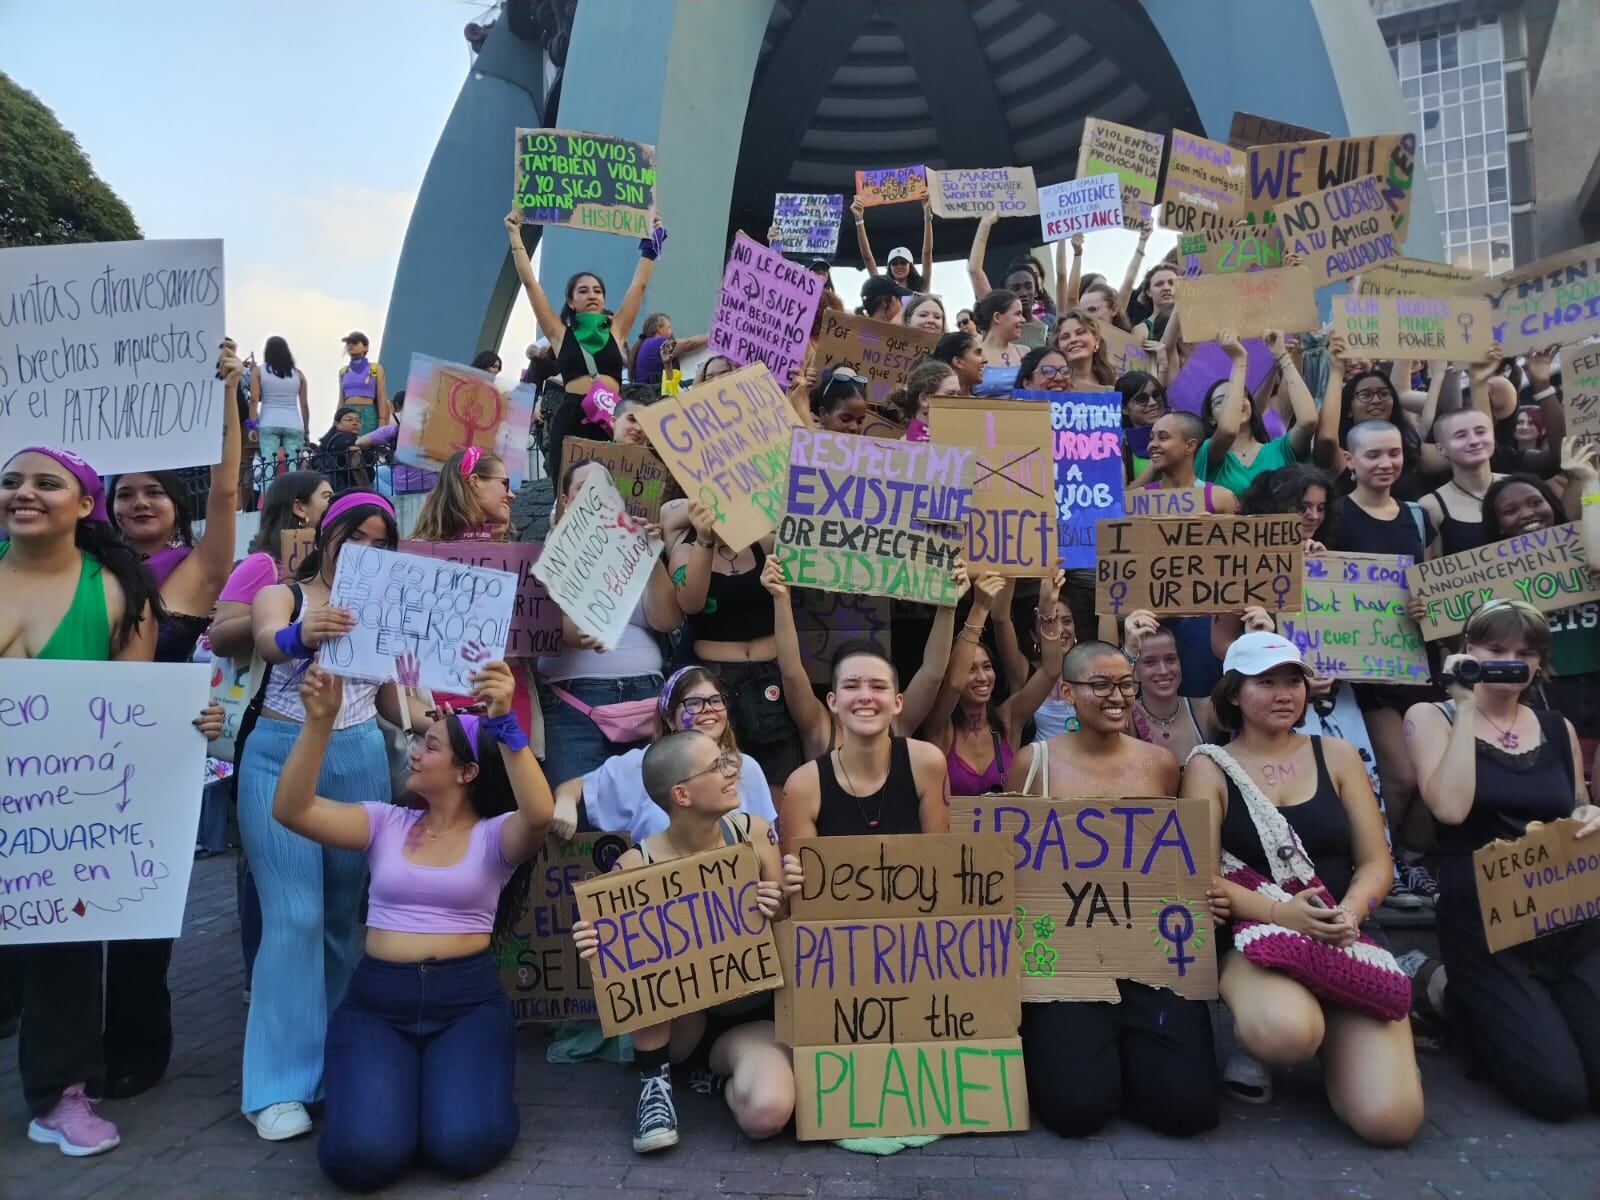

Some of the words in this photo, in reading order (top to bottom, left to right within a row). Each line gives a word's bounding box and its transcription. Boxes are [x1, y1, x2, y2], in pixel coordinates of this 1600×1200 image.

[527, 135, 558, 153] LOS
[568, 137, 636, 163] NOVIOS
[1095, 138, 1116, 152] SON
[1119, 146, 1136, 159] LOS
[1139, 153, 1158, 168] QUE
[1097, 127, 1160, 155] VIOLENTOS
[520, 154, 597, 177] TAMBIÉN
[942, 172, 952, 183] I
[958, 169, 1009, 182] MARCH
[1090, 149, 1143, 173] PROVOCAN
[1175, 162, 1190, 174] con
[1192, 167, 1207, 181] mis
[1210, 174, 1240, 192] amigos
[1251, 147, 1306, 200] WE
[515, 194, 573, 209] CONTAR
[520, 175, 530, 192] Y
[536, 175, 554, 193] YO
[561, 178, 602, 199] SIGO
[615, 182, 643, 204] SIN
[943, 182, 960, 191] SO
[962, 182, 979, 191] MY
[979, 190, 994, 198] BE
[1058, 184, 1115, 207] EXISTENCE
[581, 207, 650, 237] HISTORIA
[998, 200, 1026, 211] TOO
[1047, 208, 1121, 236] RESISTANCE
[1165, 200, 1196, 232] POR
[1284, 201, 1320, 236] NO
[1323, 175, 1384, 222] CUBRAS
[1294, 239, 1310, 255] A
[1307, 230, 1327, 249] TU
[1332, 217, 1379, 249] AMIGO
[734, 242, 752, 265] NO
[756, 254, 772, 273] LE
[774, 262, 816, 296] CREAS
[1326, 233, 1399, 278] ABUSADOR
[0, 272, 81, 327] untas
[91, 264, 221, 318] atravesamos
[731, 269, 740, 289] A
[743, 272, 807, 325] DISNEY
[1344, 300, 1379, 316] OUR
[719, 309, 731, 326] SE
[735, 317, 793, 353] CONVIERTE
[721, 293, 745, 313] UNA
[748, 305, 782, 331] BESTIA
[784, 323, 804, 344] NO
[1347, 316, 1379, 331] OUR
[1398, 316, 1445, 331] MINDS
[1520, 295, 1600, 336] CHOI
[826, 317, 851, 339] Por
[886, 337, 909, 353] que
[1348, 332, 1379, 346] OUR
[1398, 332, 1445, 347] POWER
[17, 337, 99, 384] brechas
[114, 324, 207, 378] impuestas
[714, 328, 733, 351] EN
[738, 338, 798, 381] PRINCIPE
[863, 349, 880, 363] NO
[869, 366, 890, 379] que
[29, 388, 48, 418] el
[660, 388, 744, 454] GIRLS
[736, 373, 786, 416] JUST
[1051, 401, 1122, 431] BORTION
[677, 431, 750, 483] WANNA
[747, 406, 793, 443] HAVE
[984, 410, 996, 448] I
[1052, 431, 1121, 460] URDER
[791, 428, 918, 478] RESPECT
[924, 446, 970, 489] MY
[1067, 464, 1083, 481] A
[787, 465, 973, 538] EXISTENCE
[1124, 492, 1195, 515] UNTAS
[543, 487, 602, 580] ANYTHING
[779, 517, 815, 546] OR
[820, 520, 922, 557] EXPECT
[923, 537, 963, 571] MY
[1107, 523, 1133, 554] I
[1158, 523, 1251, 546] WEAR
[1254, 521, 1302, 547] HEELS
[342, 546, 383, 578] NO
[390, 560, 424, 584] es
[1214, 554, 1293, 577] THAN
[1419, 548, 1492, 582] PUBLIC
[1496, 522, 1581, 558] CERVIX
[776, 545, 958, 604] RESISTANCE
[1416, 544, 1568, 598] ANNOUNCEMENT
[385, 583, 473, 616] acoso
[588, 588, 616, 626] DO
[1150, 581, 1182, 608] UR
[1192, 580, 1267, 605] DICK
[1304, 587, 1341, 613] but
[1350, 589, 1405, 616] have
[1426, 588, 1493, 627] FUCK
[1548, 603, 1599, 633] ETS
[320, 634, 354, 668] NO
[527, 629, 563, 653] YOU?
[1323, 629, 1360, 645] ever
[0, 695, 49, 727] ero
[89, 696, 157, 740] que
[7, 741, 122, 777] mamá
[0, 785, 74, 814] erme
[0, 822, 154, 861] RADUARME,
[74, 863, 111, 882] en
[131, 852, 154, 878] la
[800, 843, 937, 913] Destroy
[953, 844, 1005, 906] the
[1482, 845, 1549, 881] VERGA
[1523, 854, 1600, 888] VIOLADO
[587, 880, 650, 917] THIS
[662, 871, 684, 898] IS
[699, 854, 739, 889] MY
[1063, 882, 1132, 929] YA!
[1490, 907, 1501, 926] A
[1514, 896, 1537, 919] LA
[593, 880, 768, 979] RESISTING
[794, 917, 1013, 988] PATRIARCHY
[606, 963, 701, 1024] BITCH
[709, 942, 777, 994] FACE
[834, 997, 908, 1044] NOT
[925, 994, 978, 1039] the
[814, 1047, 1022, 1128] PLANET
